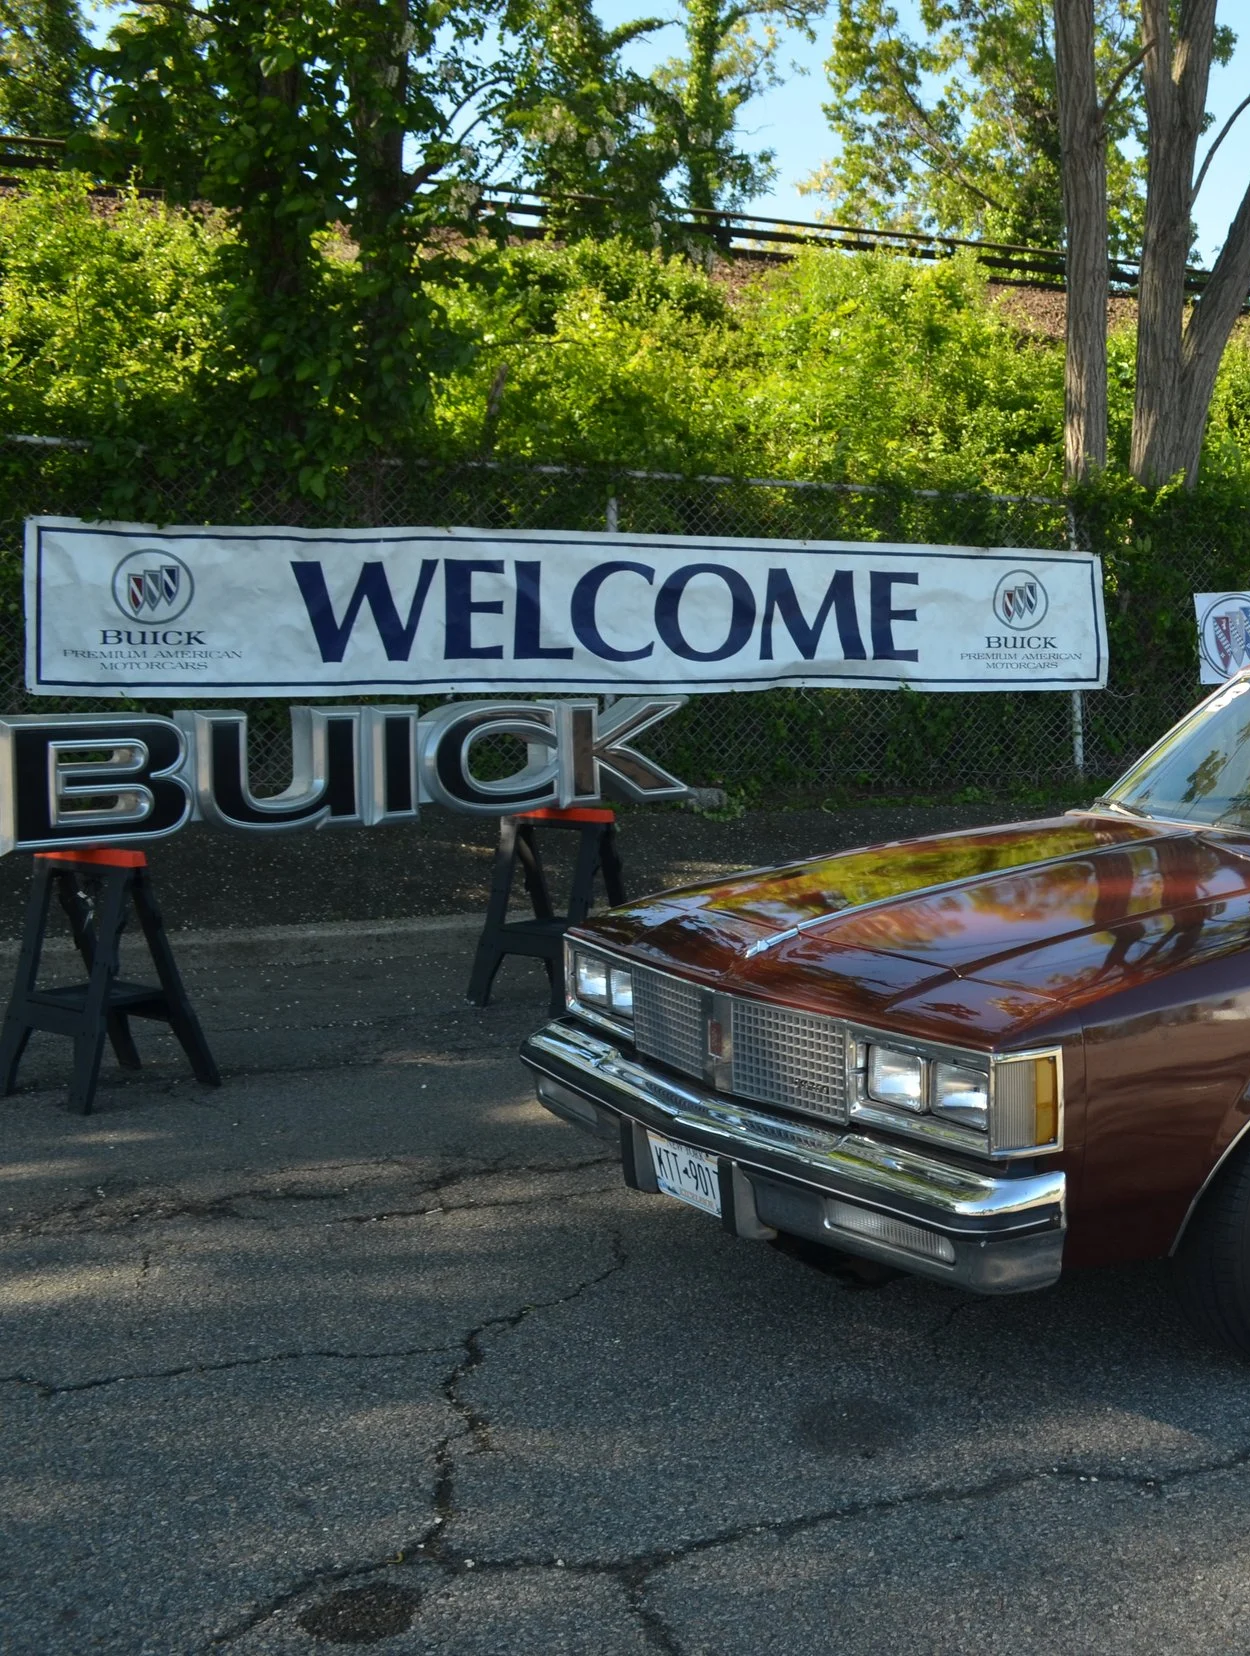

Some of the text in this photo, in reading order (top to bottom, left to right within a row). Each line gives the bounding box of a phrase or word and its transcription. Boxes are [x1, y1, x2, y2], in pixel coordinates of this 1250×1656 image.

[290, 558, 921, 664] WELCOME
[100, 629, 207, 646] BUICK
[985, 635, 1058, 649] BUICK
[62, 649, 243, 660] PREMIUM AMERICAN
[960, 652, 1082, 660] PREMIUM AMERICAN
[99, 661, 208, 671] MOTORCARS
[986, 661, 1058, 670] MOTORCARS
[0, 696, 691, 856] BUICK
